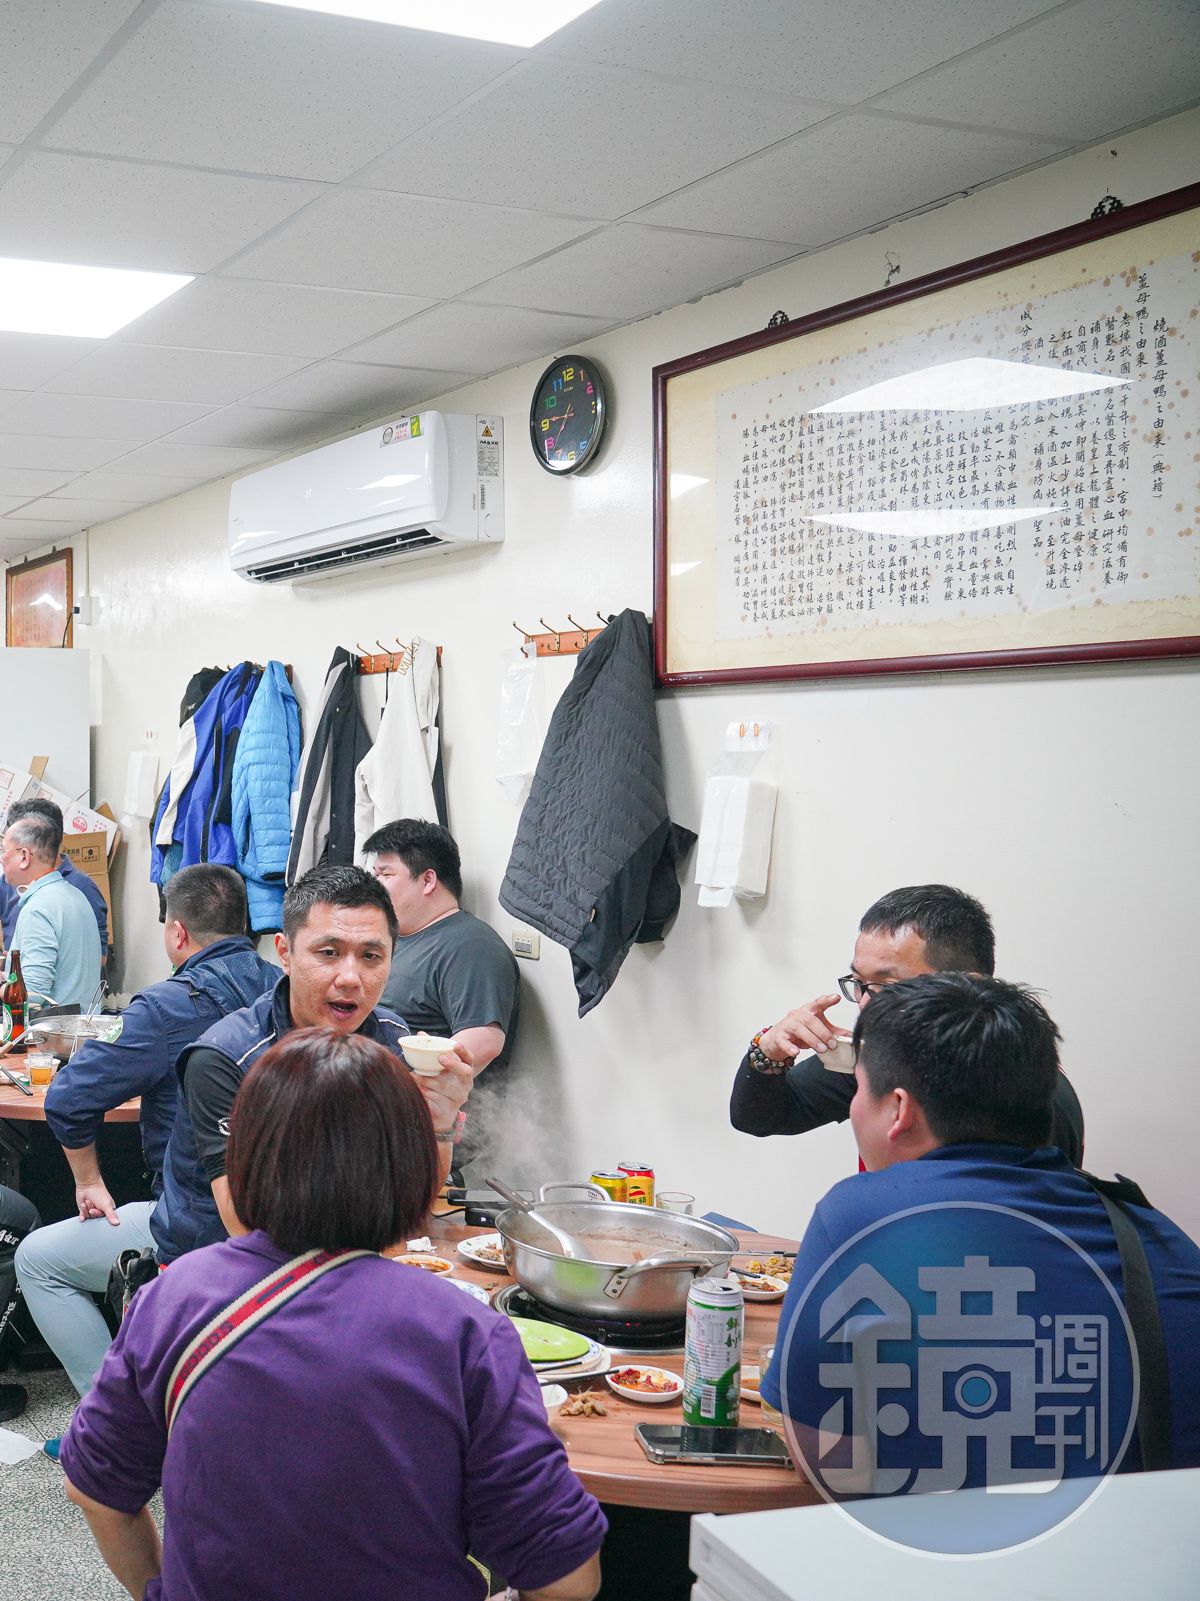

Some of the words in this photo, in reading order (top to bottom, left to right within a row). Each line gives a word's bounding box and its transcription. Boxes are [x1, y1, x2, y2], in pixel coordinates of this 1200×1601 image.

[562, 367, 575, 382] 12
[544, 395, 557, 409] 10
[540, 418, 550, 432] 9
